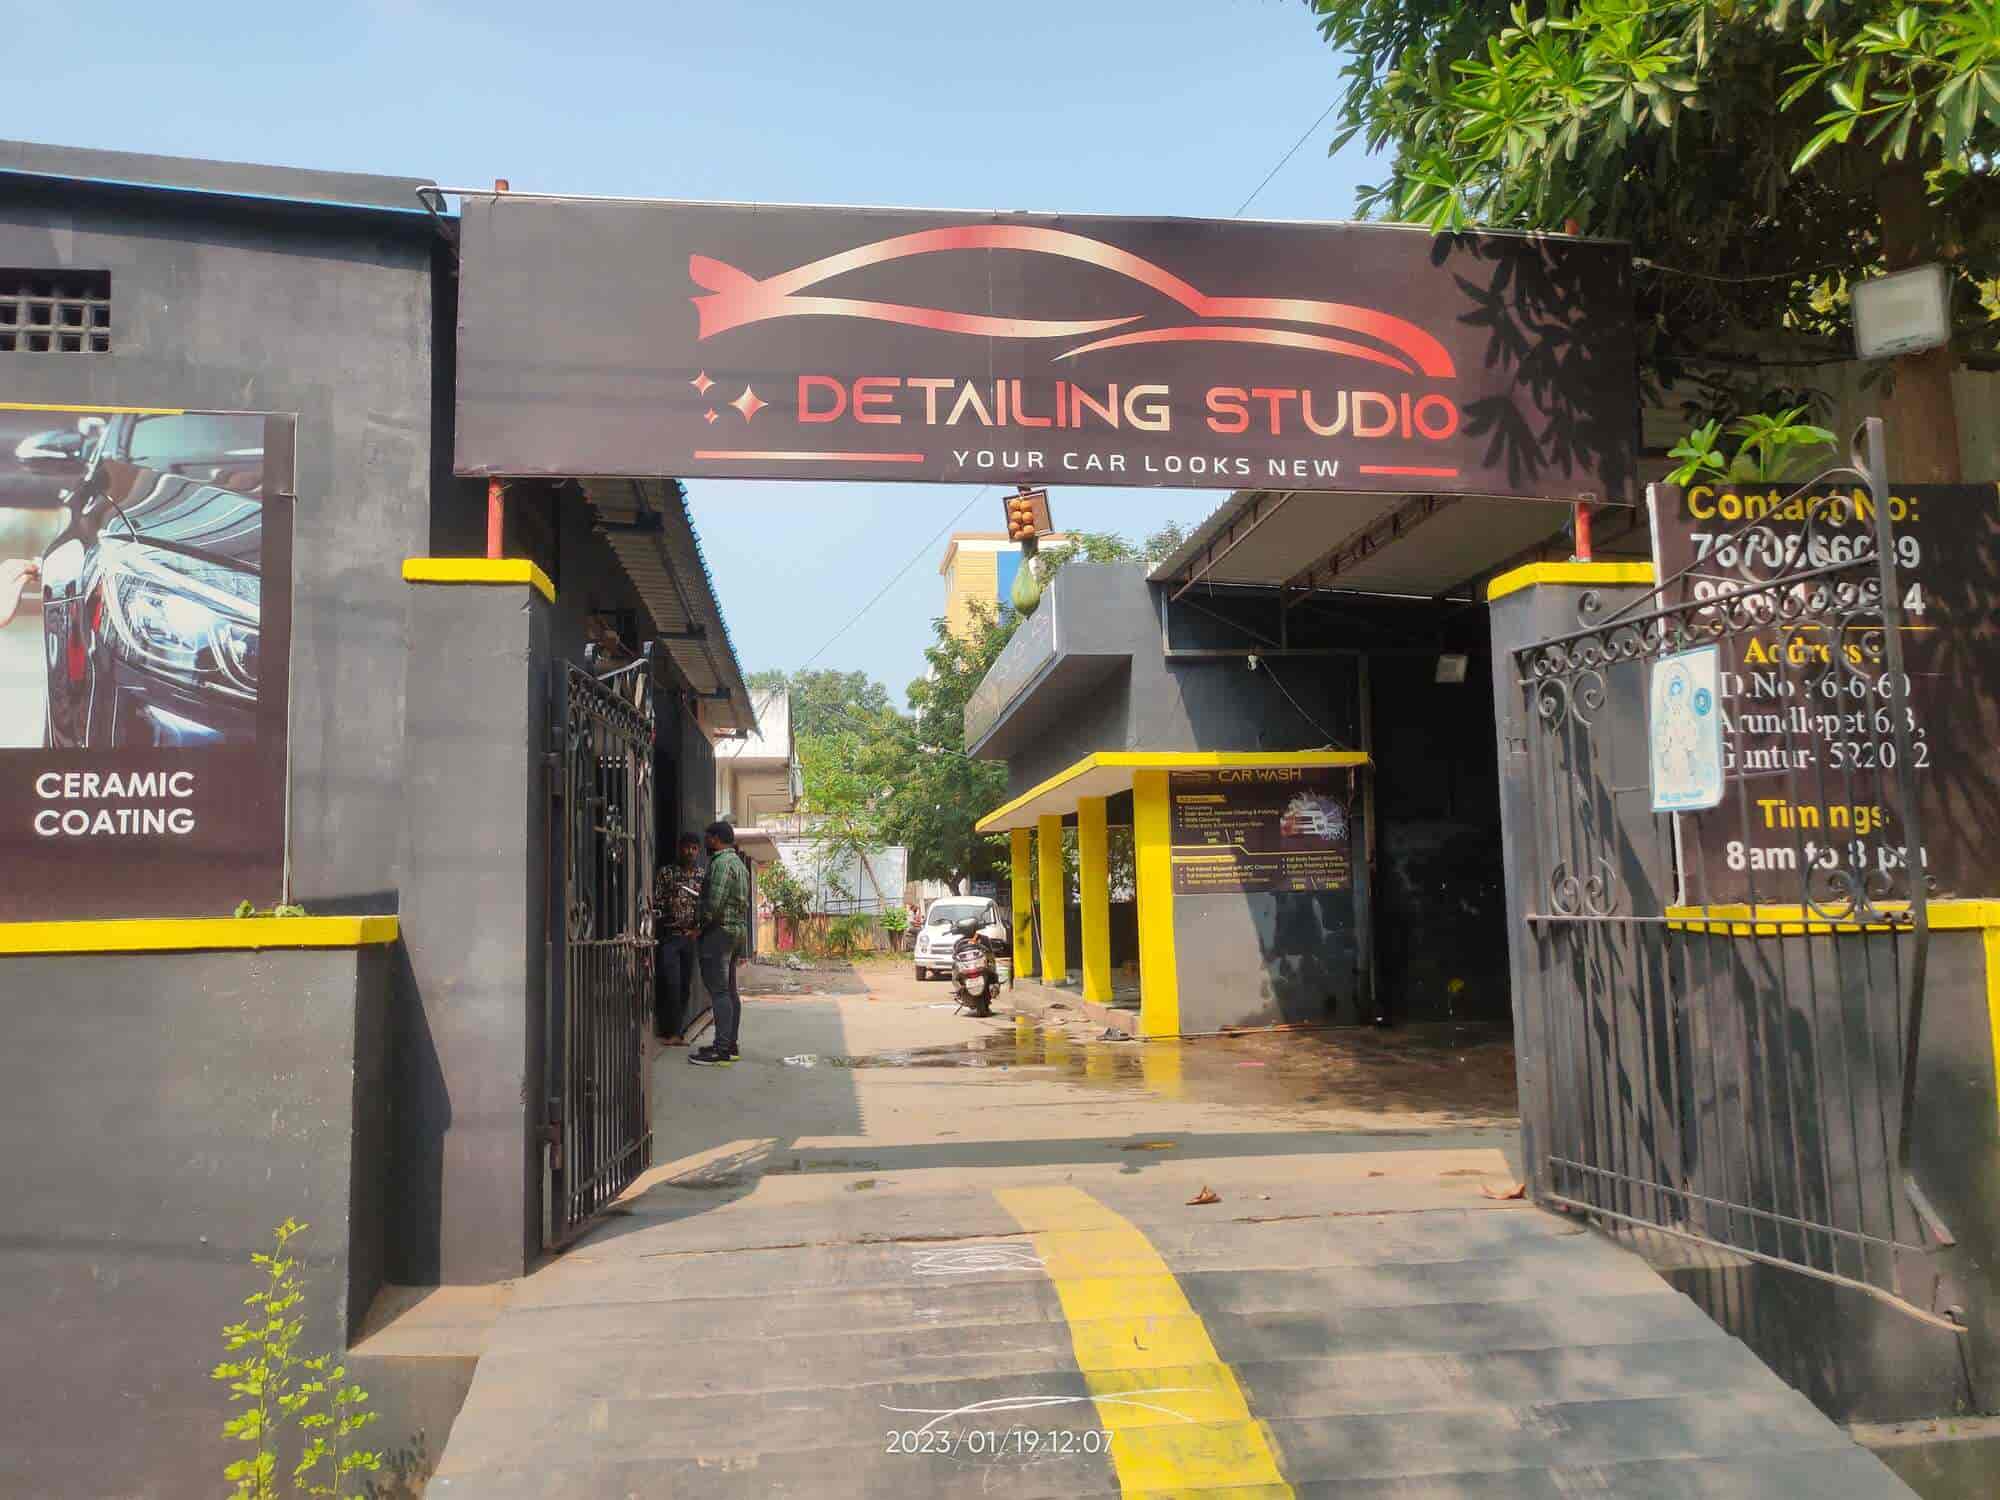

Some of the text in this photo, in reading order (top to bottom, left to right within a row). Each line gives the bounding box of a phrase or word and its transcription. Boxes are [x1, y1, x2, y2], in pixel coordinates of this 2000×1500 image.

[798, 375, 1459, 441] DETAILING STUDIO
[953, 449, 1340, 478] YOUR CAR LOOKS NEW
[1687, 486, 1848, 521] Contact
[1829, 742, 1930, 768] 52202
[35, 771, 195, 799] CERAMIC
[34, 807, 195, 836] COATING
[1726, 841, 1797, 870] 8am
